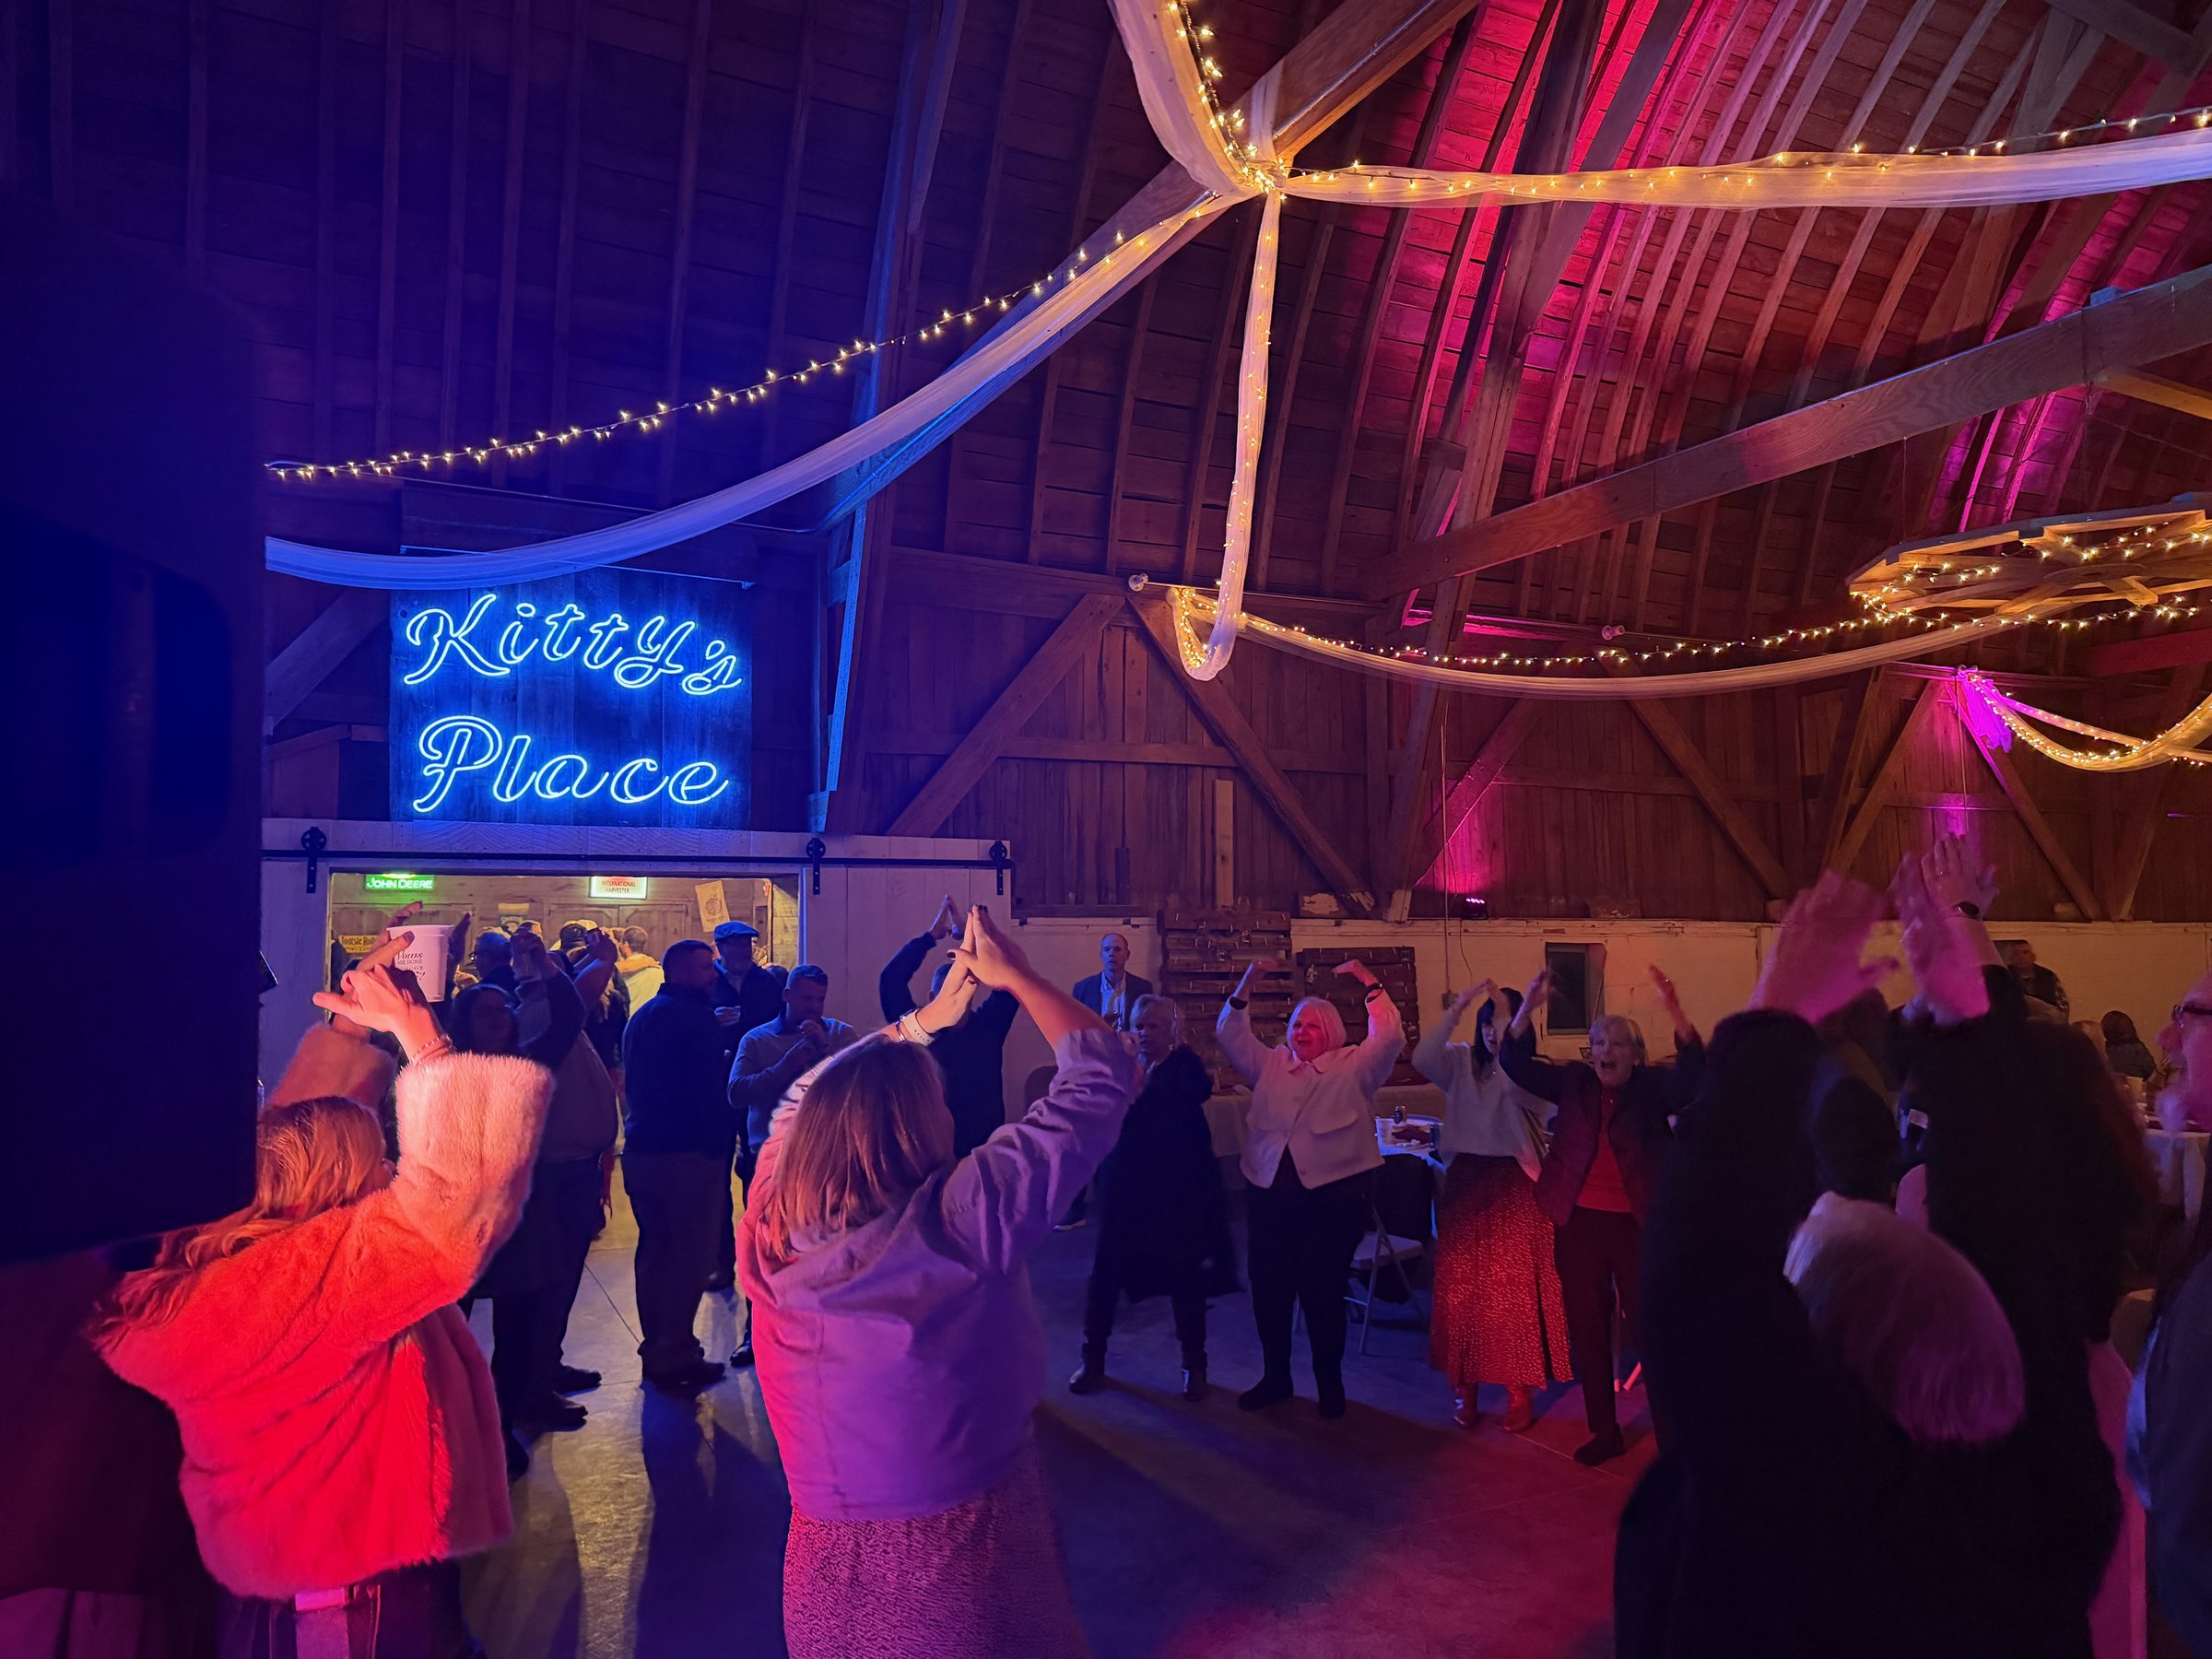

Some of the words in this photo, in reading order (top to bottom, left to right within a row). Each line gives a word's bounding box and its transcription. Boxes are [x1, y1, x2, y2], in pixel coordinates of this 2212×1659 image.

[404, 594, 743, 696] Kitty's
[412, 715, 730, 814] Place
[366, 877, 397, 889] JOHN
[398, 879, 433, 889] DEERE
